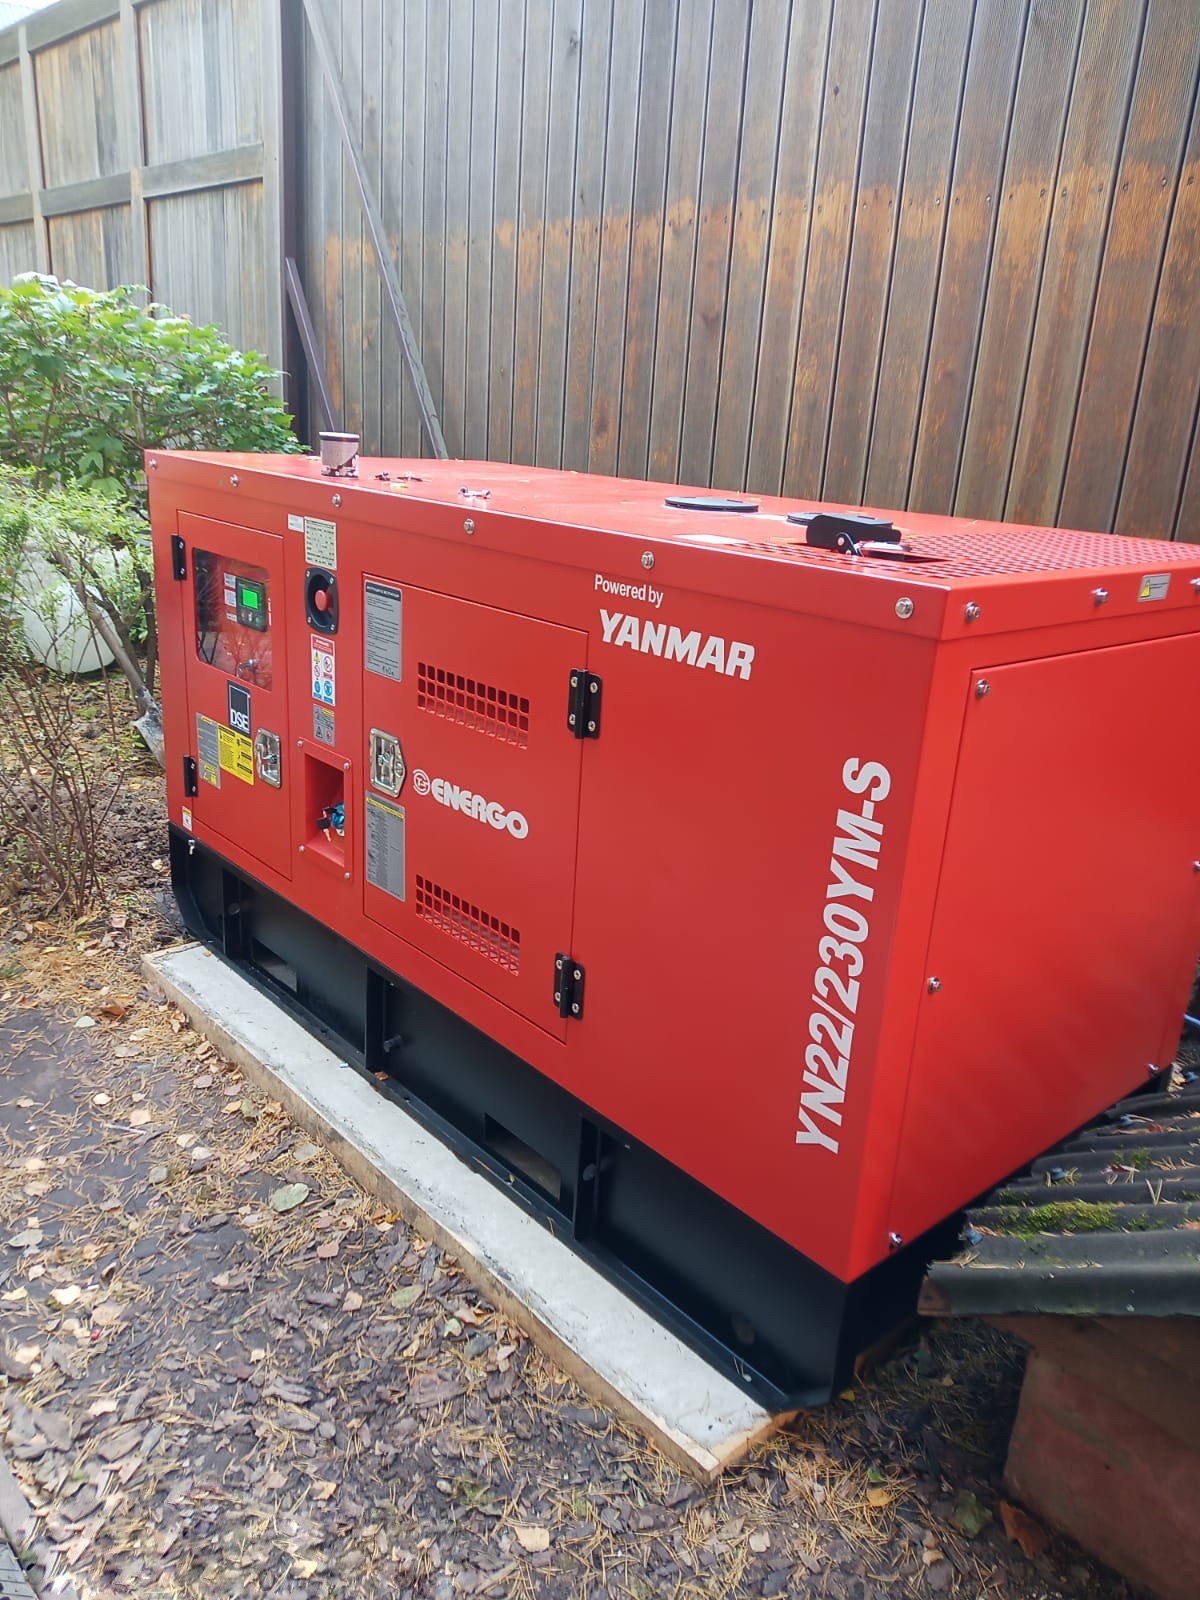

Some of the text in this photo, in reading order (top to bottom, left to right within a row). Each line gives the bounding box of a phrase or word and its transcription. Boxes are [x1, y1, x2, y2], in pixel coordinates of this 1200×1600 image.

[594, 574, 665, 608] Powered by
[600, 608, 755, 680] YANMAR
[230, 709, 250, 731] DSE
[431, 778, 529, 839] ENERGO
[795, 757, 892, 1154] YN22/230YM-S
